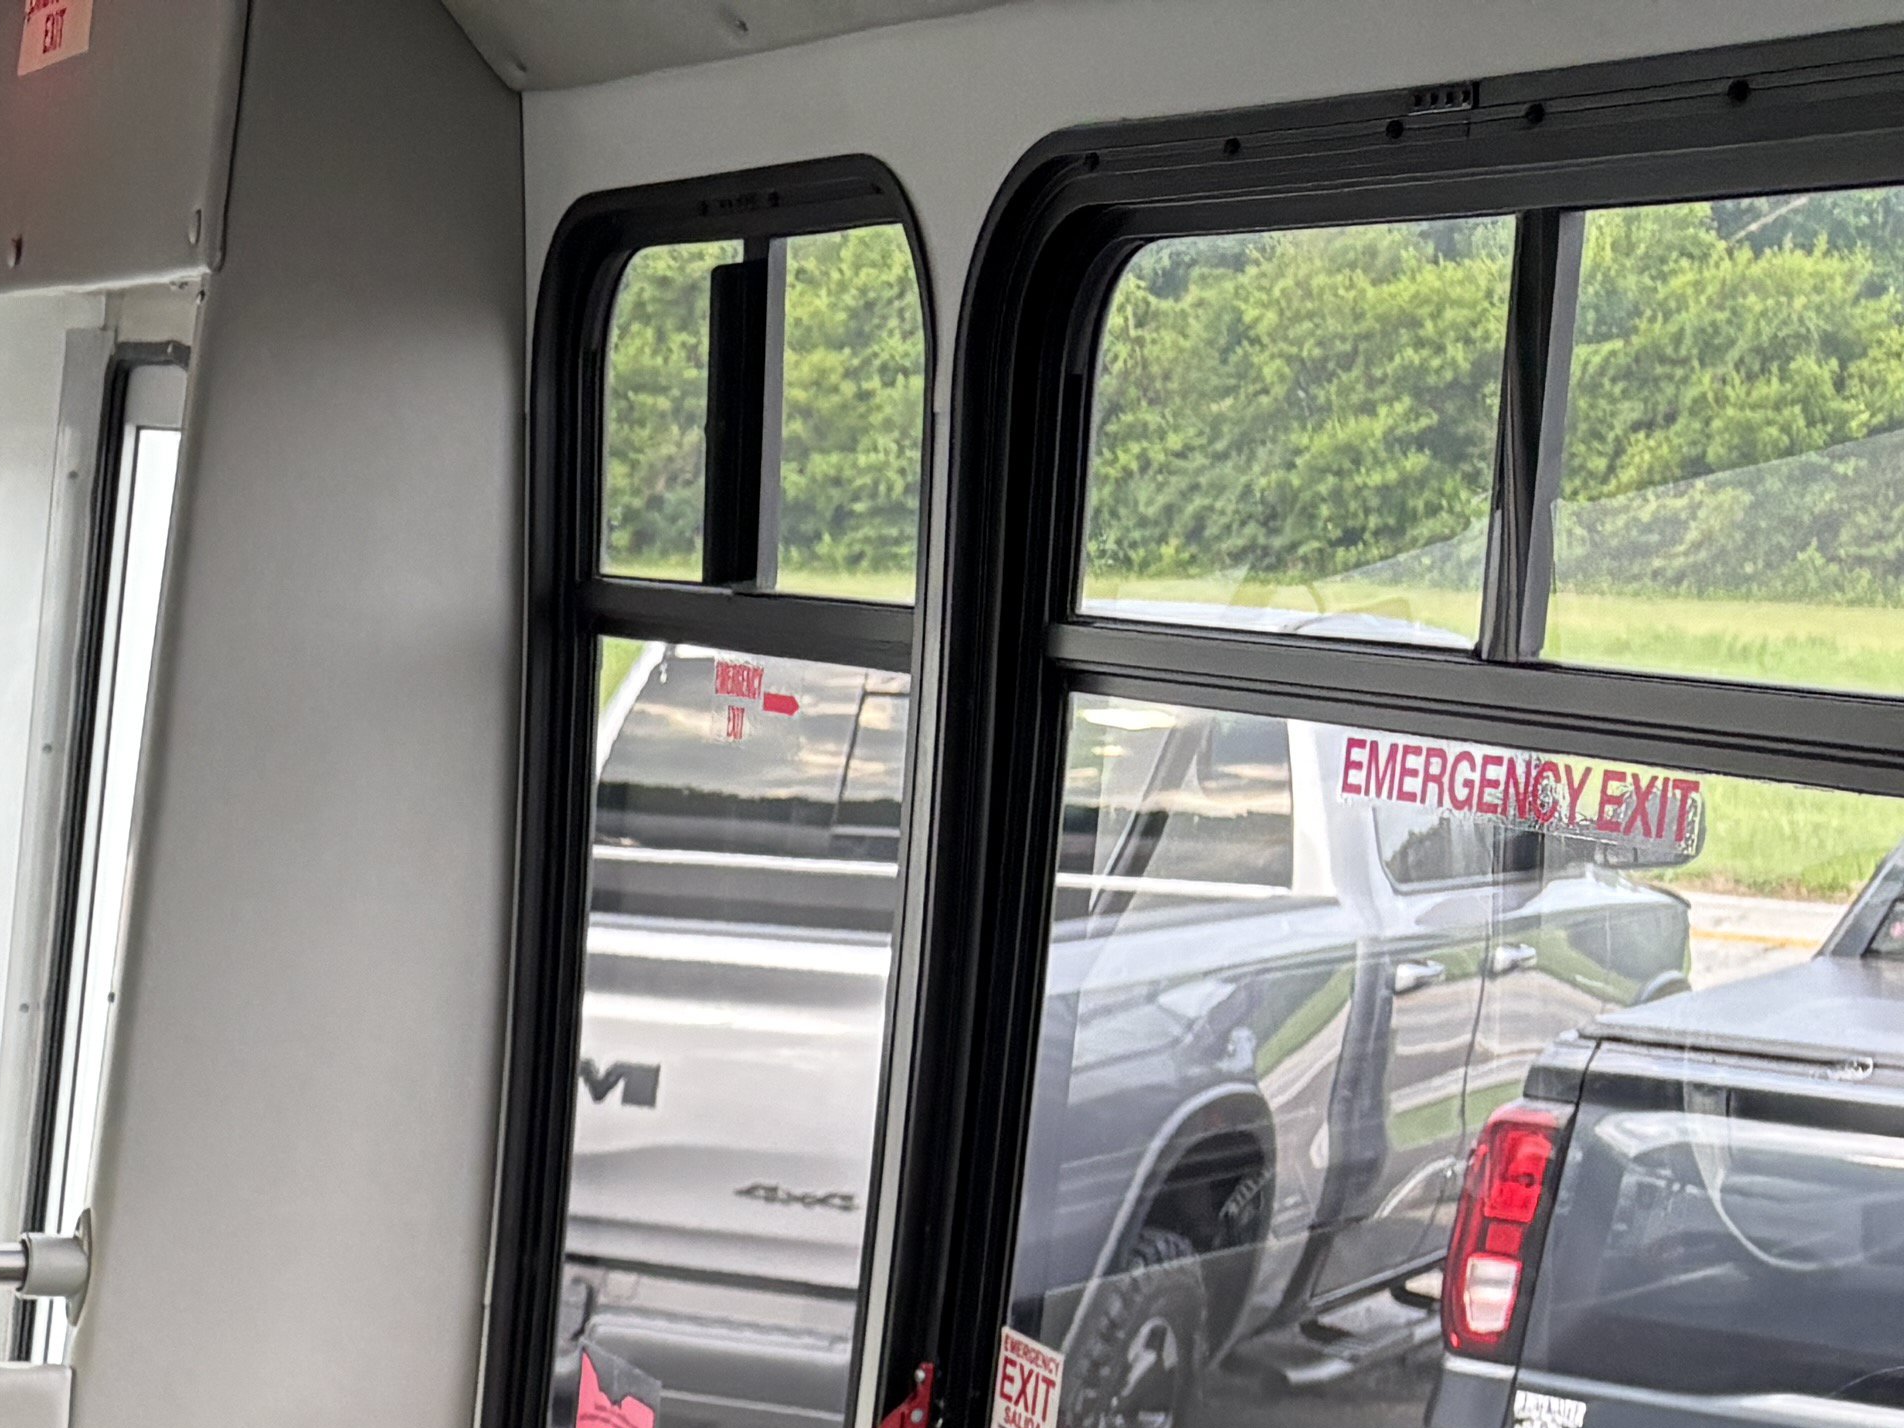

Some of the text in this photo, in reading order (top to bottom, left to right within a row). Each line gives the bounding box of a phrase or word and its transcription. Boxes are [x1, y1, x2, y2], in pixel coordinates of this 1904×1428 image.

[1342, 738, 1700, 842] EMERGENCY EXIT
[1004, 1333, 1059, 1378] EMERGENCY
[1000, 1356, 1056, 1422] EXIT
